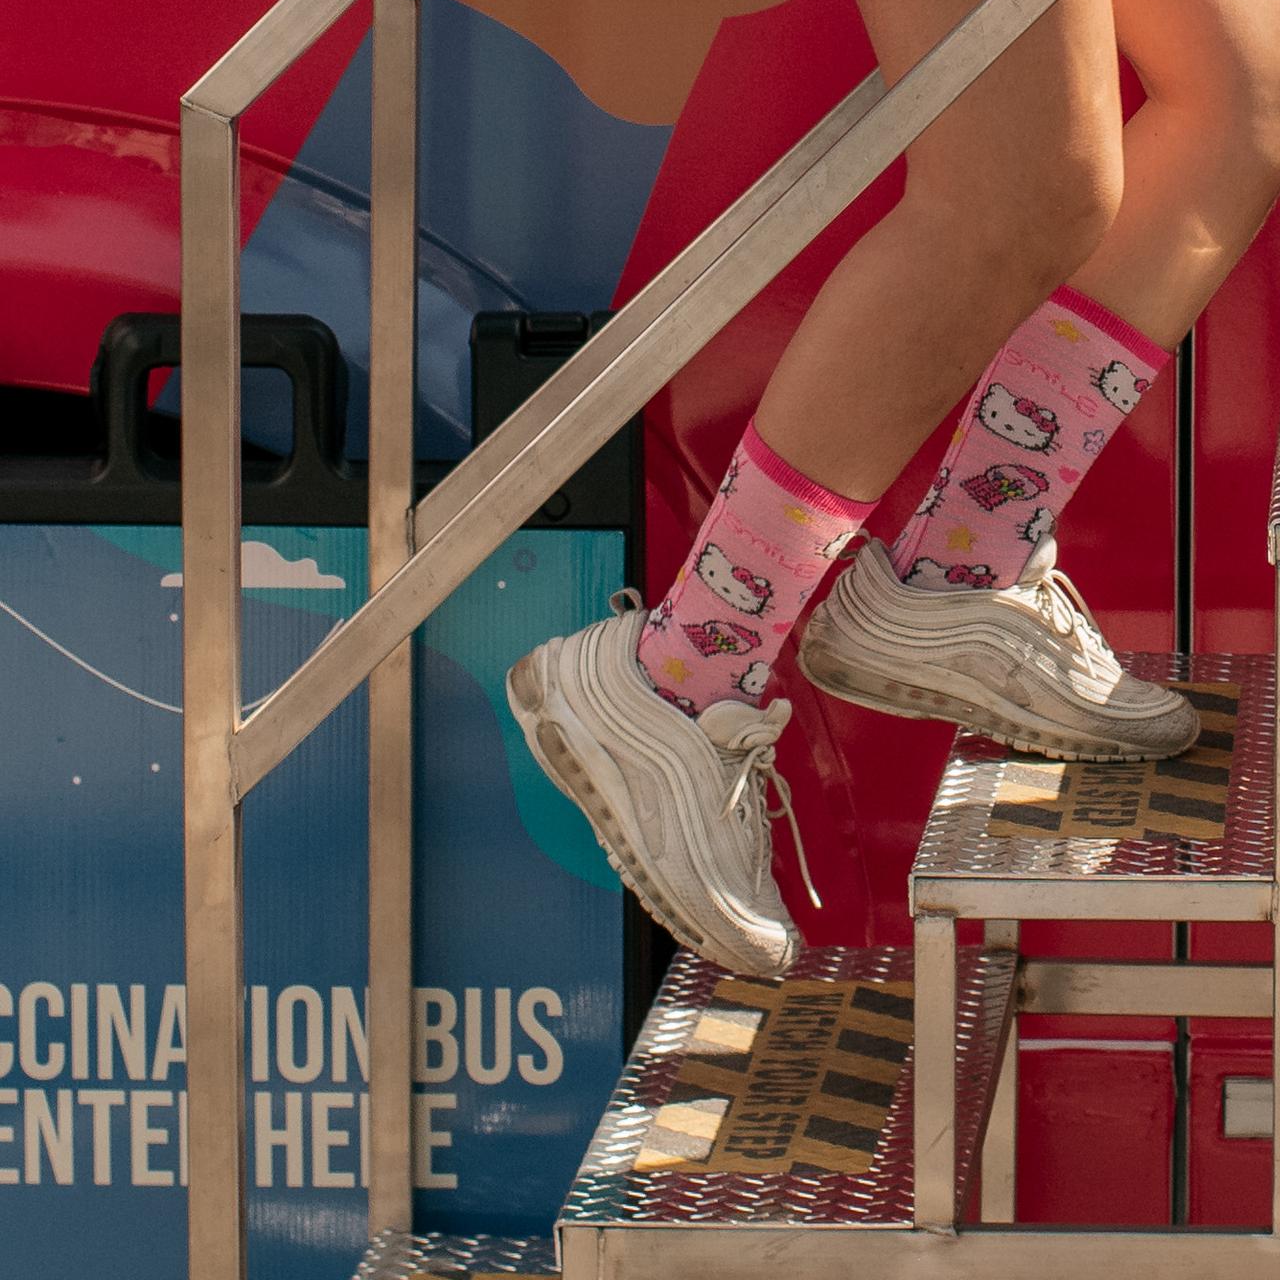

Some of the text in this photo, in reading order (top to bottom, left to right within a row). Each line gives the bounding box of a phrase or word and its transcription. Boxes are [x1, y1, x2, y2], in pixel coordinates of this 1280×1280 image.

[1071, 787, 1142, 828] STEP
[413, 987, 565, 1086] BUS
[723, 992, 845, 1160] WATCH YOUR STEP
[254, 1091, 458, 1189] HEE
